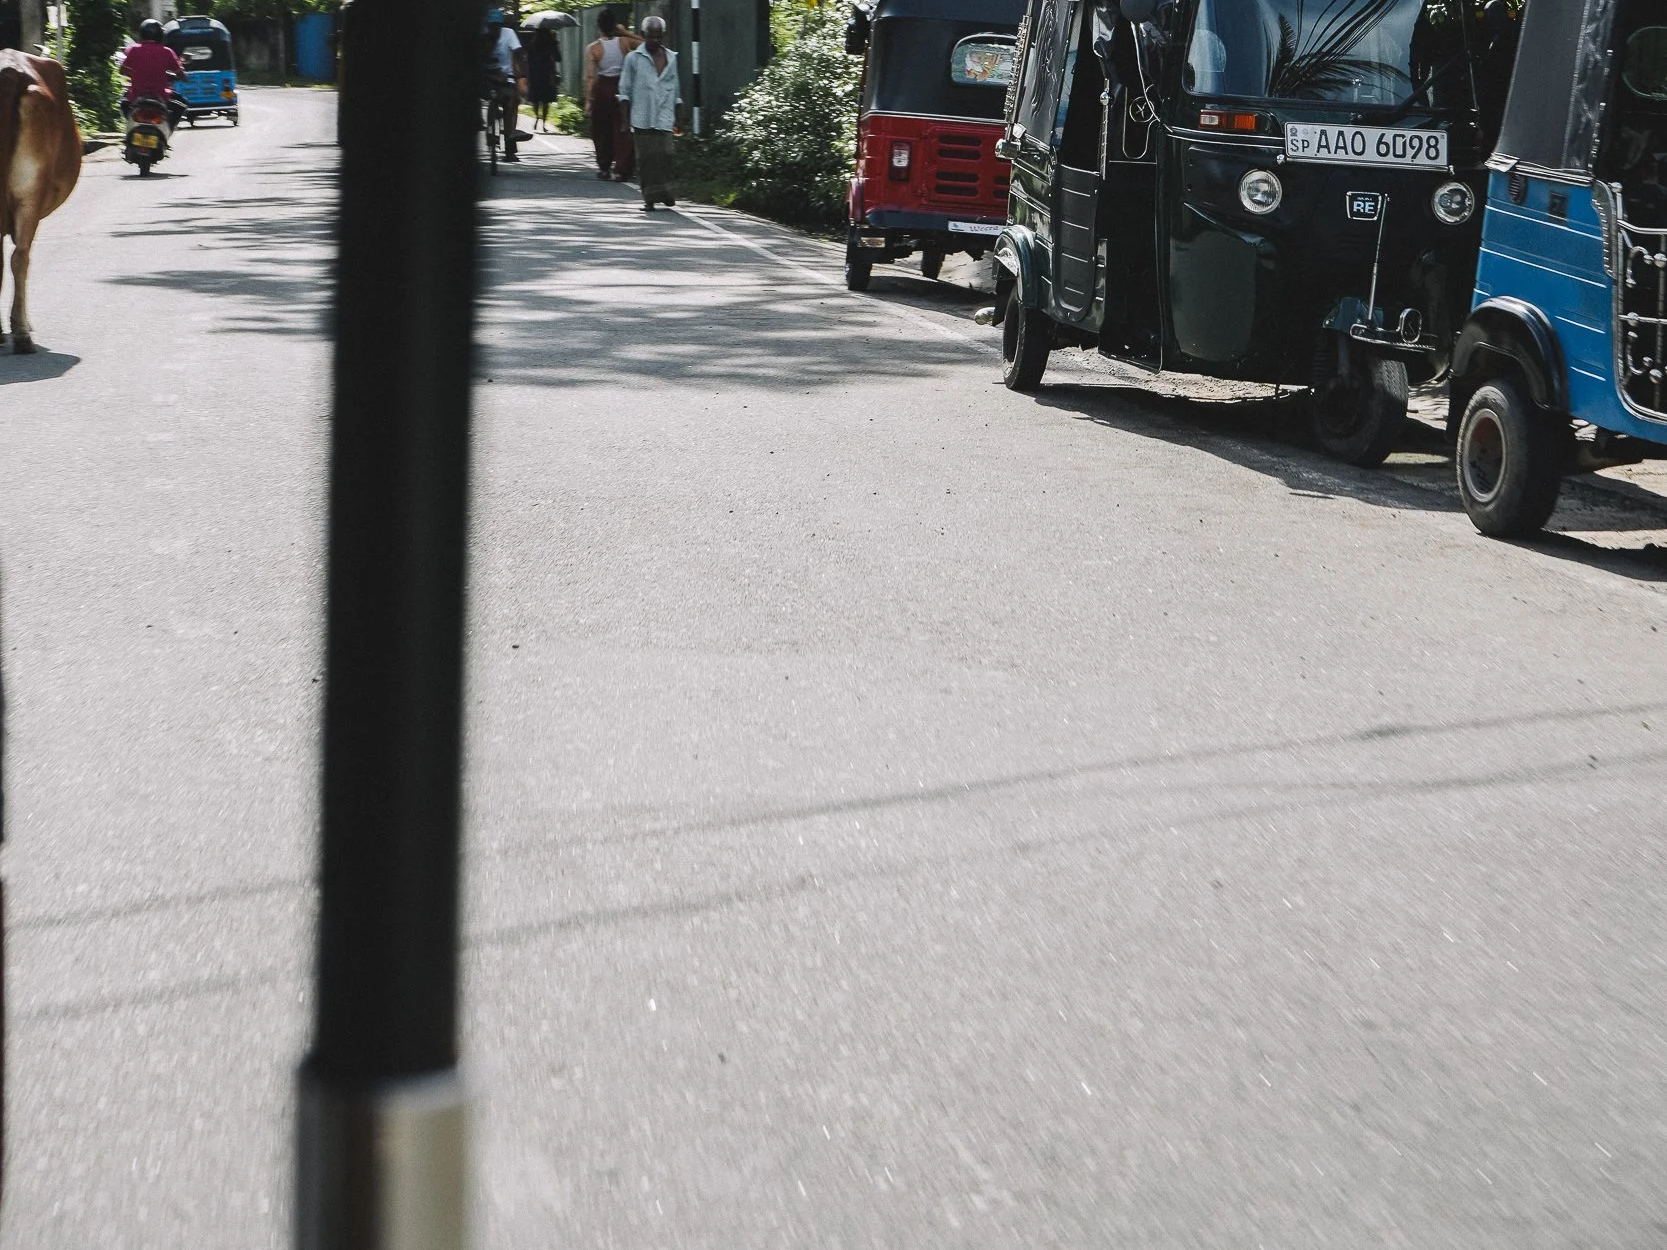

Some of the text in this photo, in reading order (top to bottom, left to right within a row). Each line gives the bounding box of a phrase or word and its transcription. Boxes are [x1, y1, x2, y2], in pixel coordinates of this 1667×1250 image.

[1290, 129, 1440, 161] SP AAO 6098
[1353, 201, 1375, 214] RE
